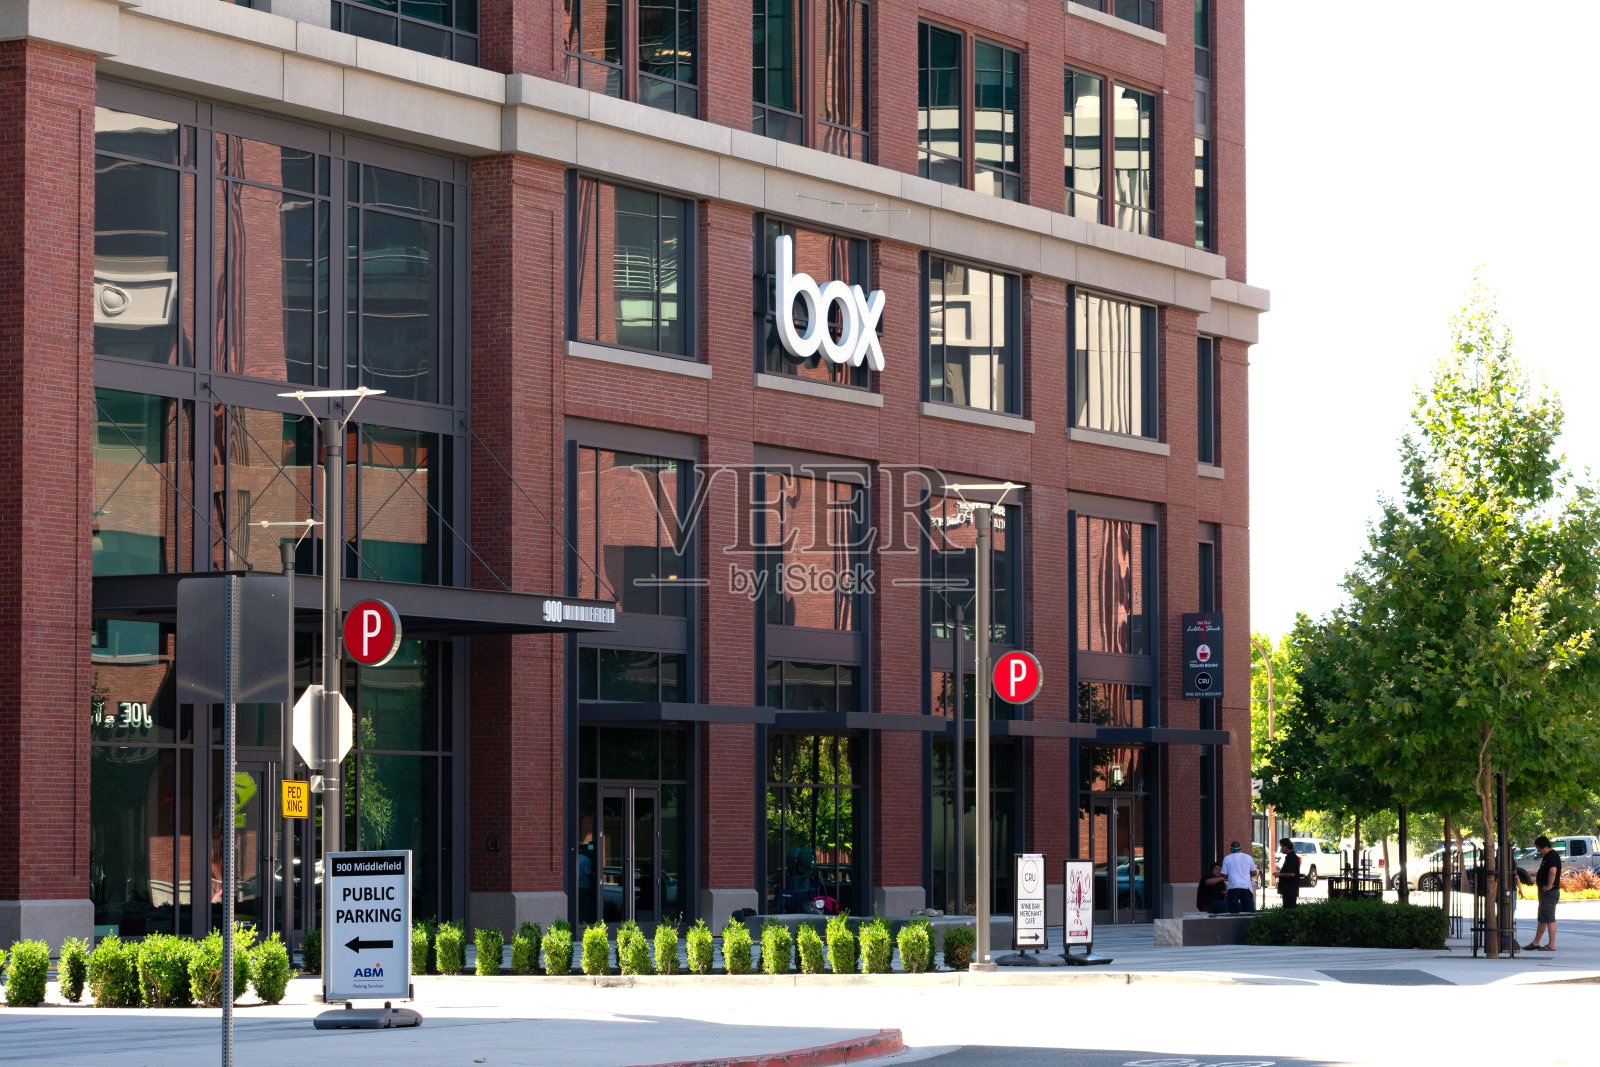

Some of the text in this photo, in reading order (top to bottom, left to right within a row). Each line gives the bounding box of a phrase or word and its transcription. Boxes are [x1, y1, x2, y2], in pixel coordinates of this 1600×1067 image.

[776, 234, 885, 371] box
[543, 600, 562, 622] 900
[363, 609, 381, 656] P
[1010, 659, 1027, 697] P
[287, 786, 302, 799] PED
[286, 800, 303, 812] XING
[336, 861, 402, 872] 900 Middlefield
[1024, 872, 1036, 882] CRU
[342, 886, 395, 902] PUBLIC
[336, 908, 402, 924] PARKING
[353, 968, 384, 978] ABM
